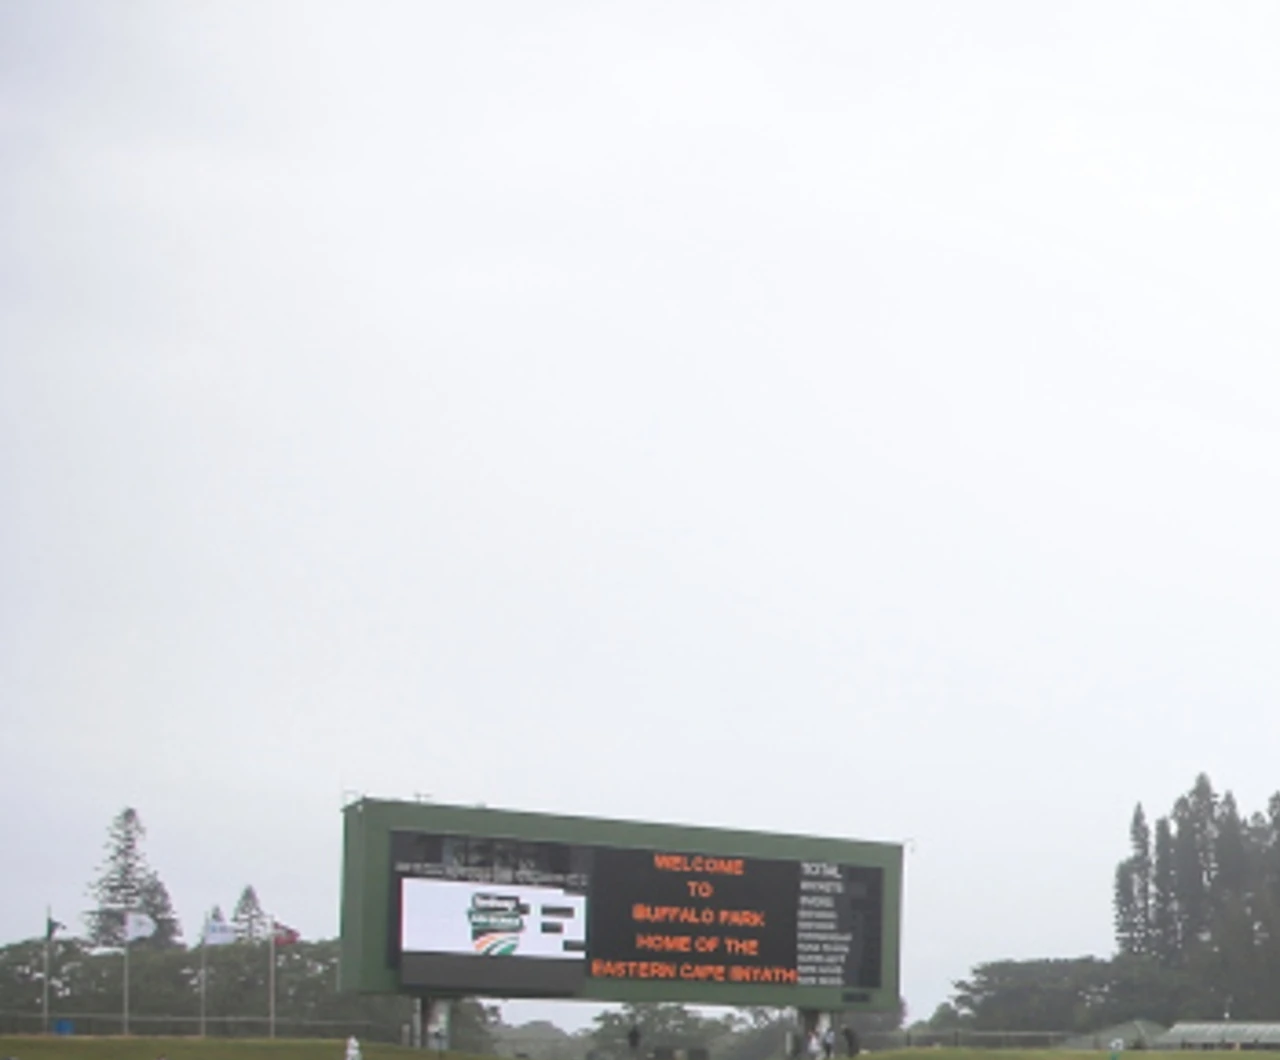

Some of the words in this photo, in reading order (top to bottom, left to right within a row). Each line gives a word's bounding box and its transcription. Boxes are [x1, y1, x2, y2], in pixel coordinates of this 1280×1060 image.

[654, 854, 744, 875] WELCOME
[687, 881, 714, 898] TO
[632, 903, 714, 924] BUFFALO
[720, 910, 765, 927] PARK
[636, 934, 691, 952] HOME
[695, 936, 719, 953] OF
[724, 938, 759, 956] THE
[591, 958, 676, 978] EASTERN
[680, 962, 725, 981] CAPE
